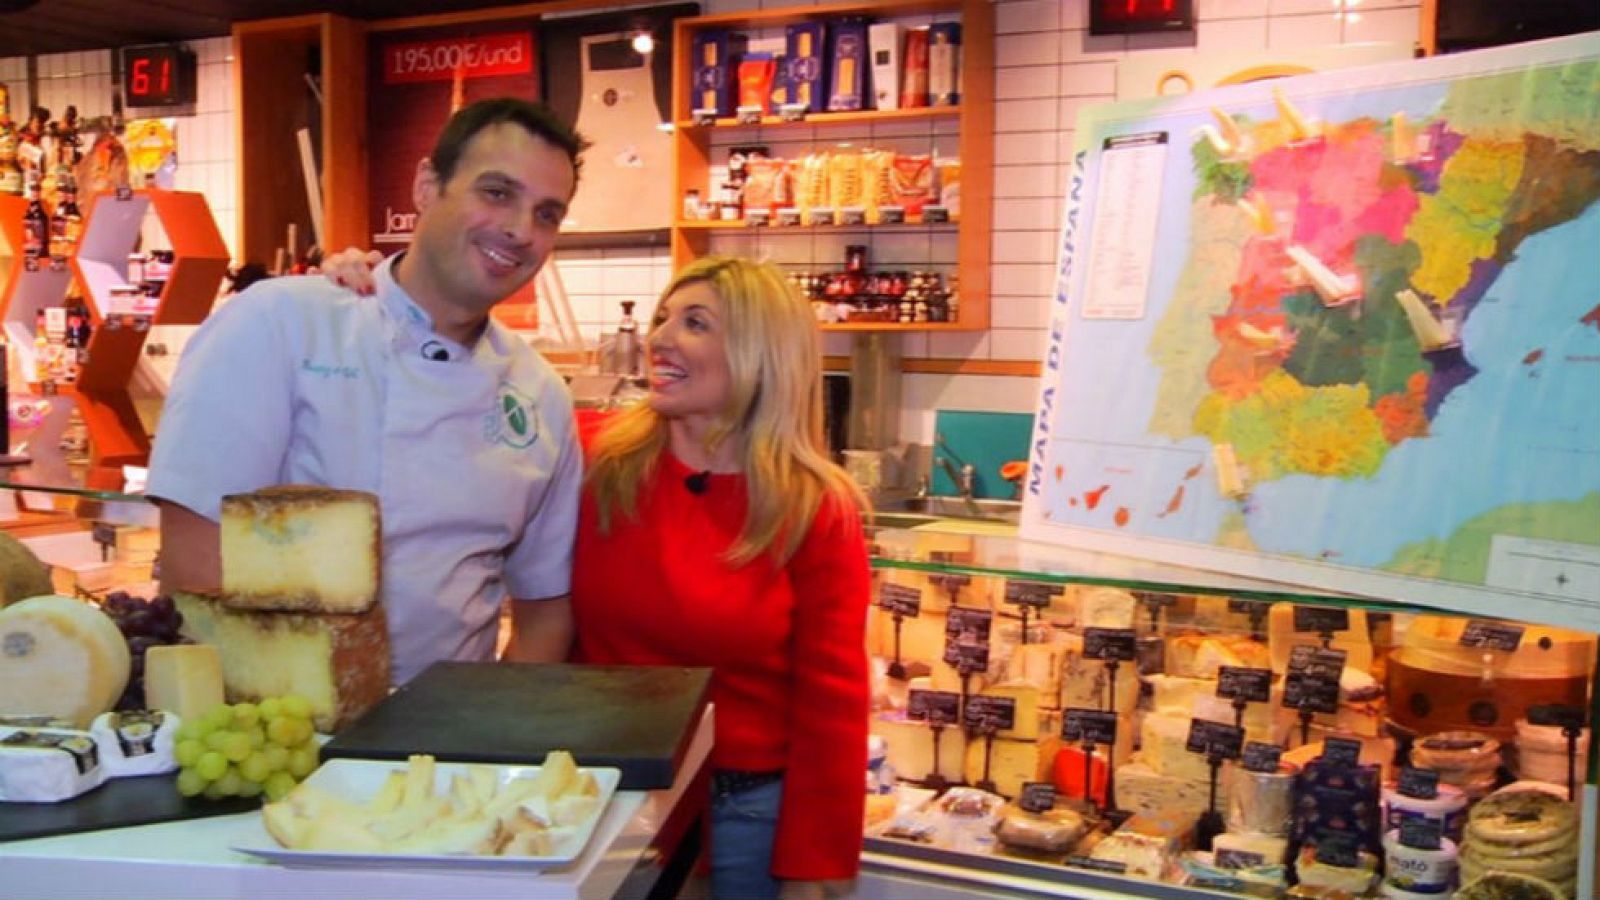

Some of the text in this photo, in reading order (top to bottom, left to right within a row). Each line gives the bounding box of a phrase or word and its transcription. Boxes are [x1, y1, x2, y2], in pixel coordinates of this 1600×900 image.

[132, 57, 169, 96] 61
[391, 40, 523, 74] 195,00€/und
[1029, 386, 1056, 497] MAPA
[1047, 319, 1064, 371] DE
